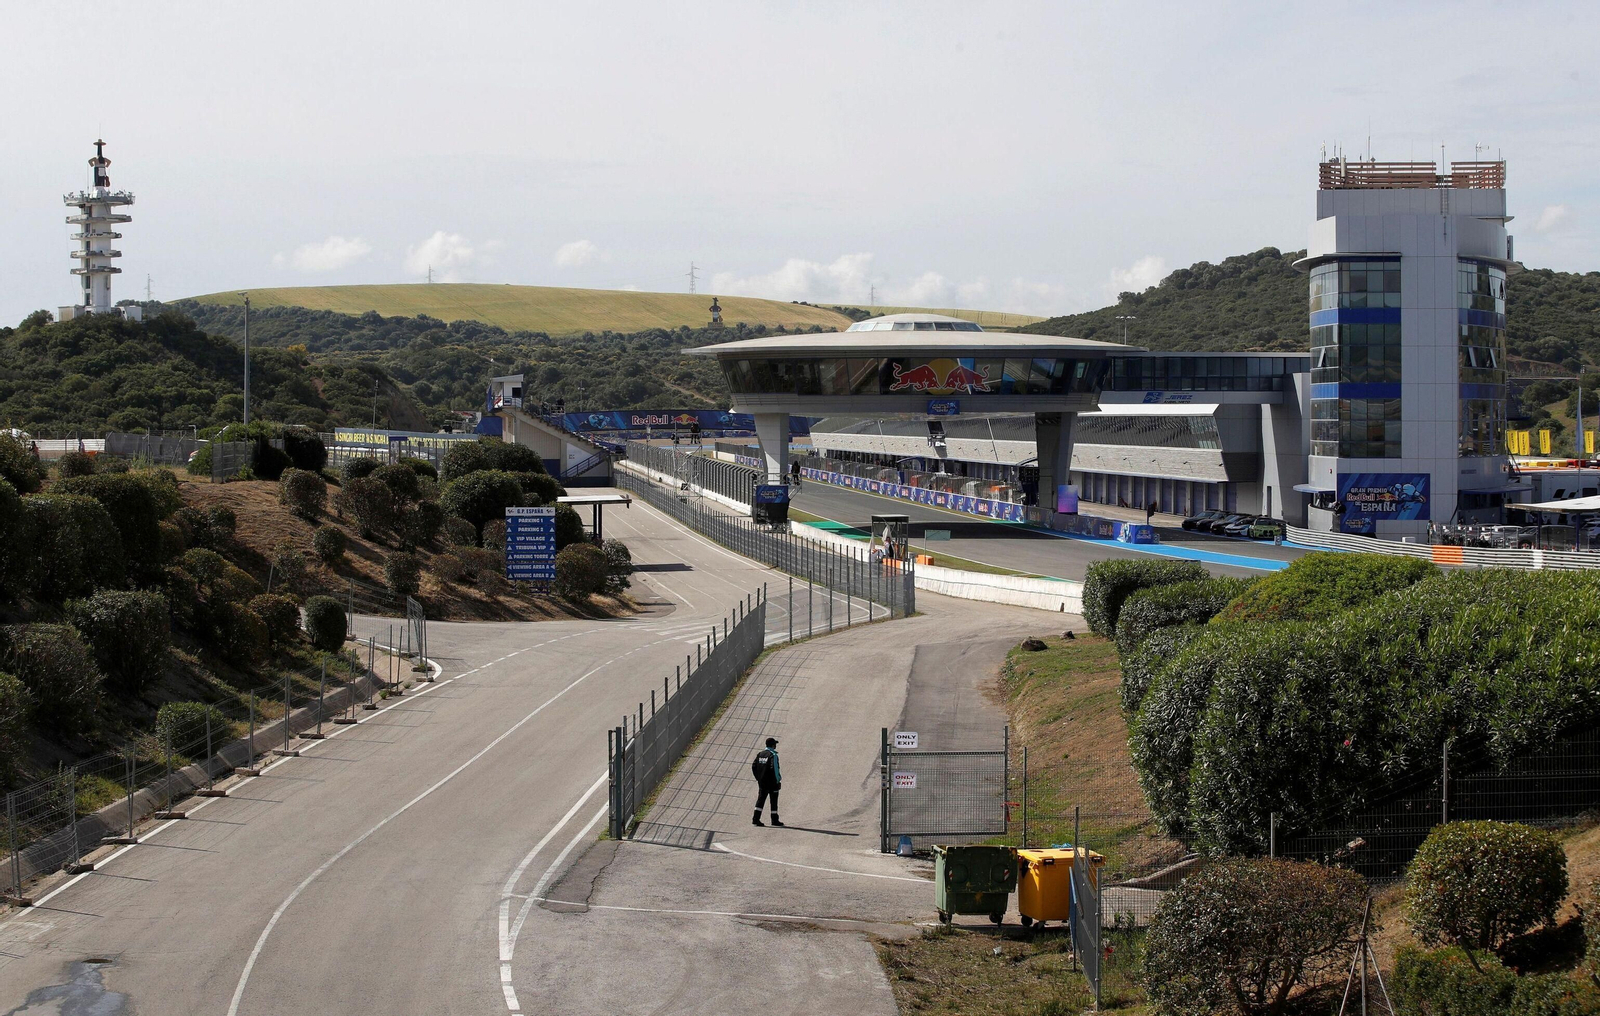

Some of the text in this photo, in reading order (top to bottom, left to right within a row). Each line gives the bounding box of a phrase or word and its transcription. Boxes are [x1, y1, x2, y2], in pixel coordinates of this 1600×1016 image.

[632, 415, 668, 425] Red Bull
[354, 433, 365, 443] BEER
[1346, 493, 1375, 501] Red Bull
[1361, 502, 1396, 512] ESPAÑA
